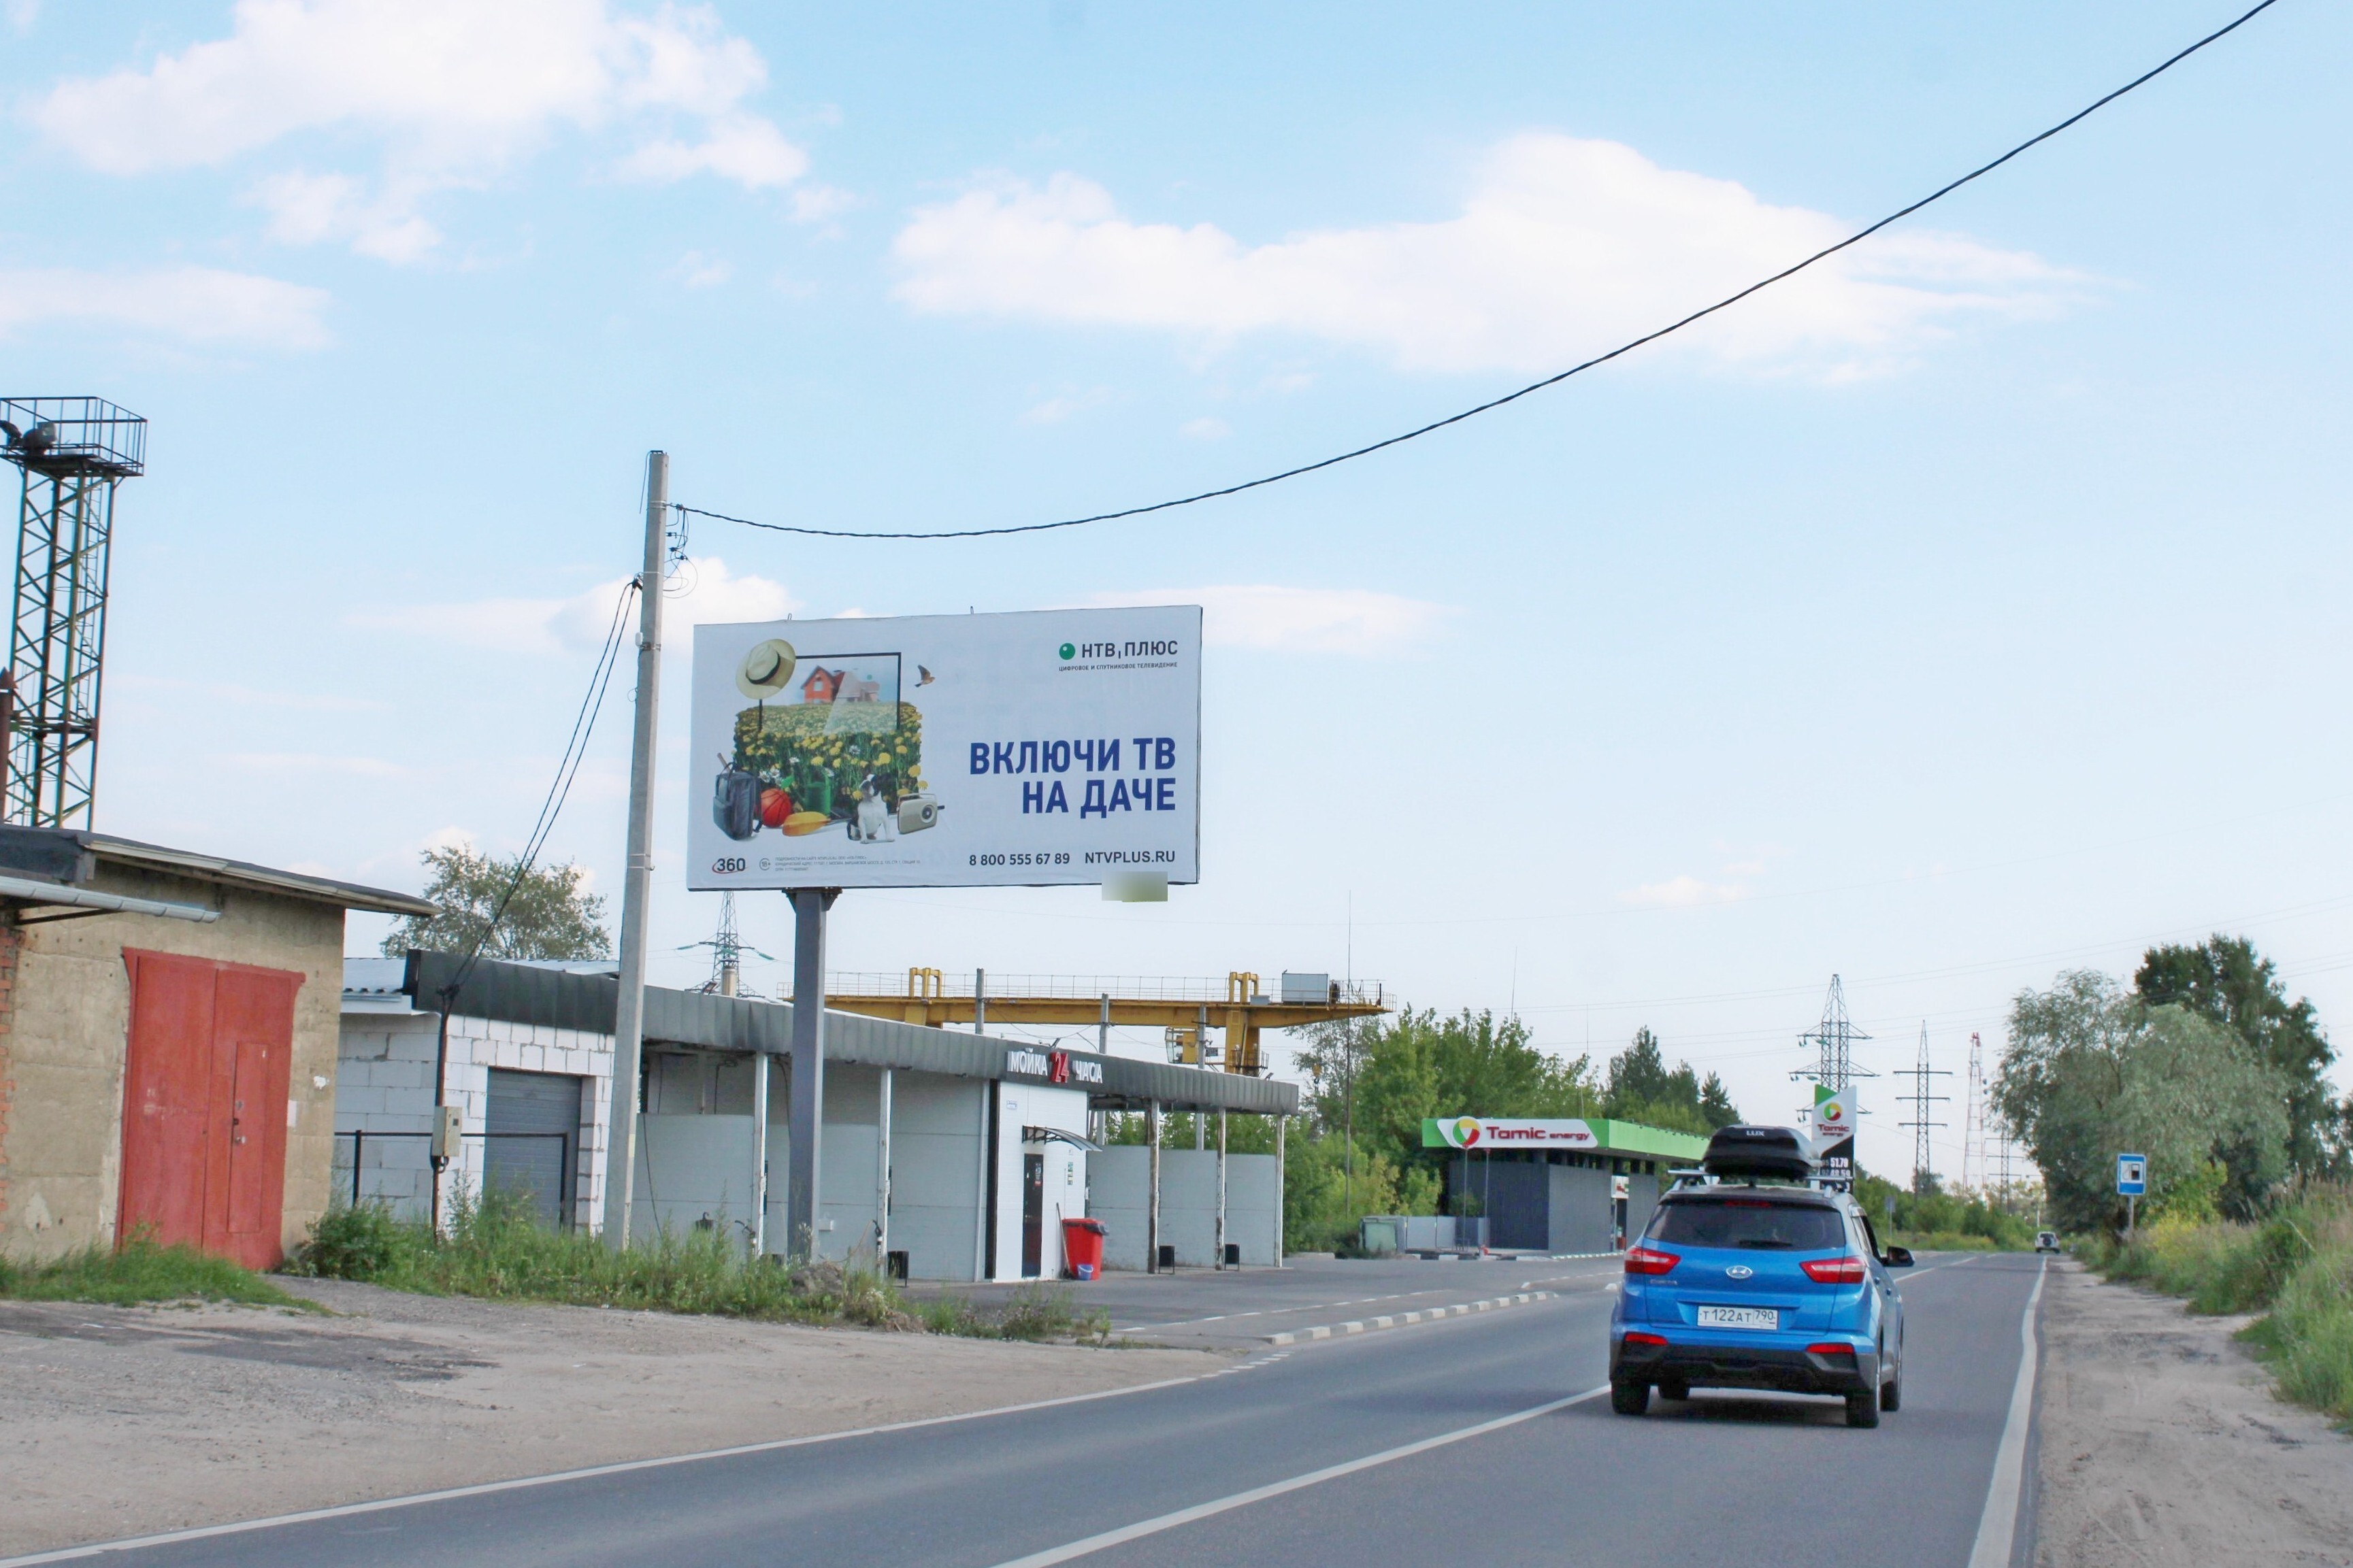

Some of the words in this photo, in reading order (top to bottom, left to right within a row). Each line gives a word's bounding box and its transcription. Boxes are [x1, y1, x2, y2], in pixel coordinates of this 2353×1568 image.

[1137, 661, 1178, 669] ТЕЛЕВИДЕНИЕ
[970, 739, 1120, 775] ВКЛЮЧИ
[1132, 737, 1176, 771] ТВ
[1022, 780, 1069, 814] НА
[1080, 778, 1176, 819] ДАЧЕ
[969, 855, 976, 865] 8
[981, 854, 1005, 865] 800
[1009, 854, 1032, 865] 555
[1036, 854, 1050, 864] 67
[1055, 853, 1070, 864] 89
[1085, 851, 1175, 863] NTVPLUS.RU
[717, 857, 746, 872] 360
[1008, 1048, 1048, 1075] МОЙКА
[1051, 1052, 1069, 1083] 24
[1073, 1061, 1102, 1083] ЧАСА
[1486, 1127, 1547, 1139] Tamic
[1756, 1310, 1774, 1320] 790
